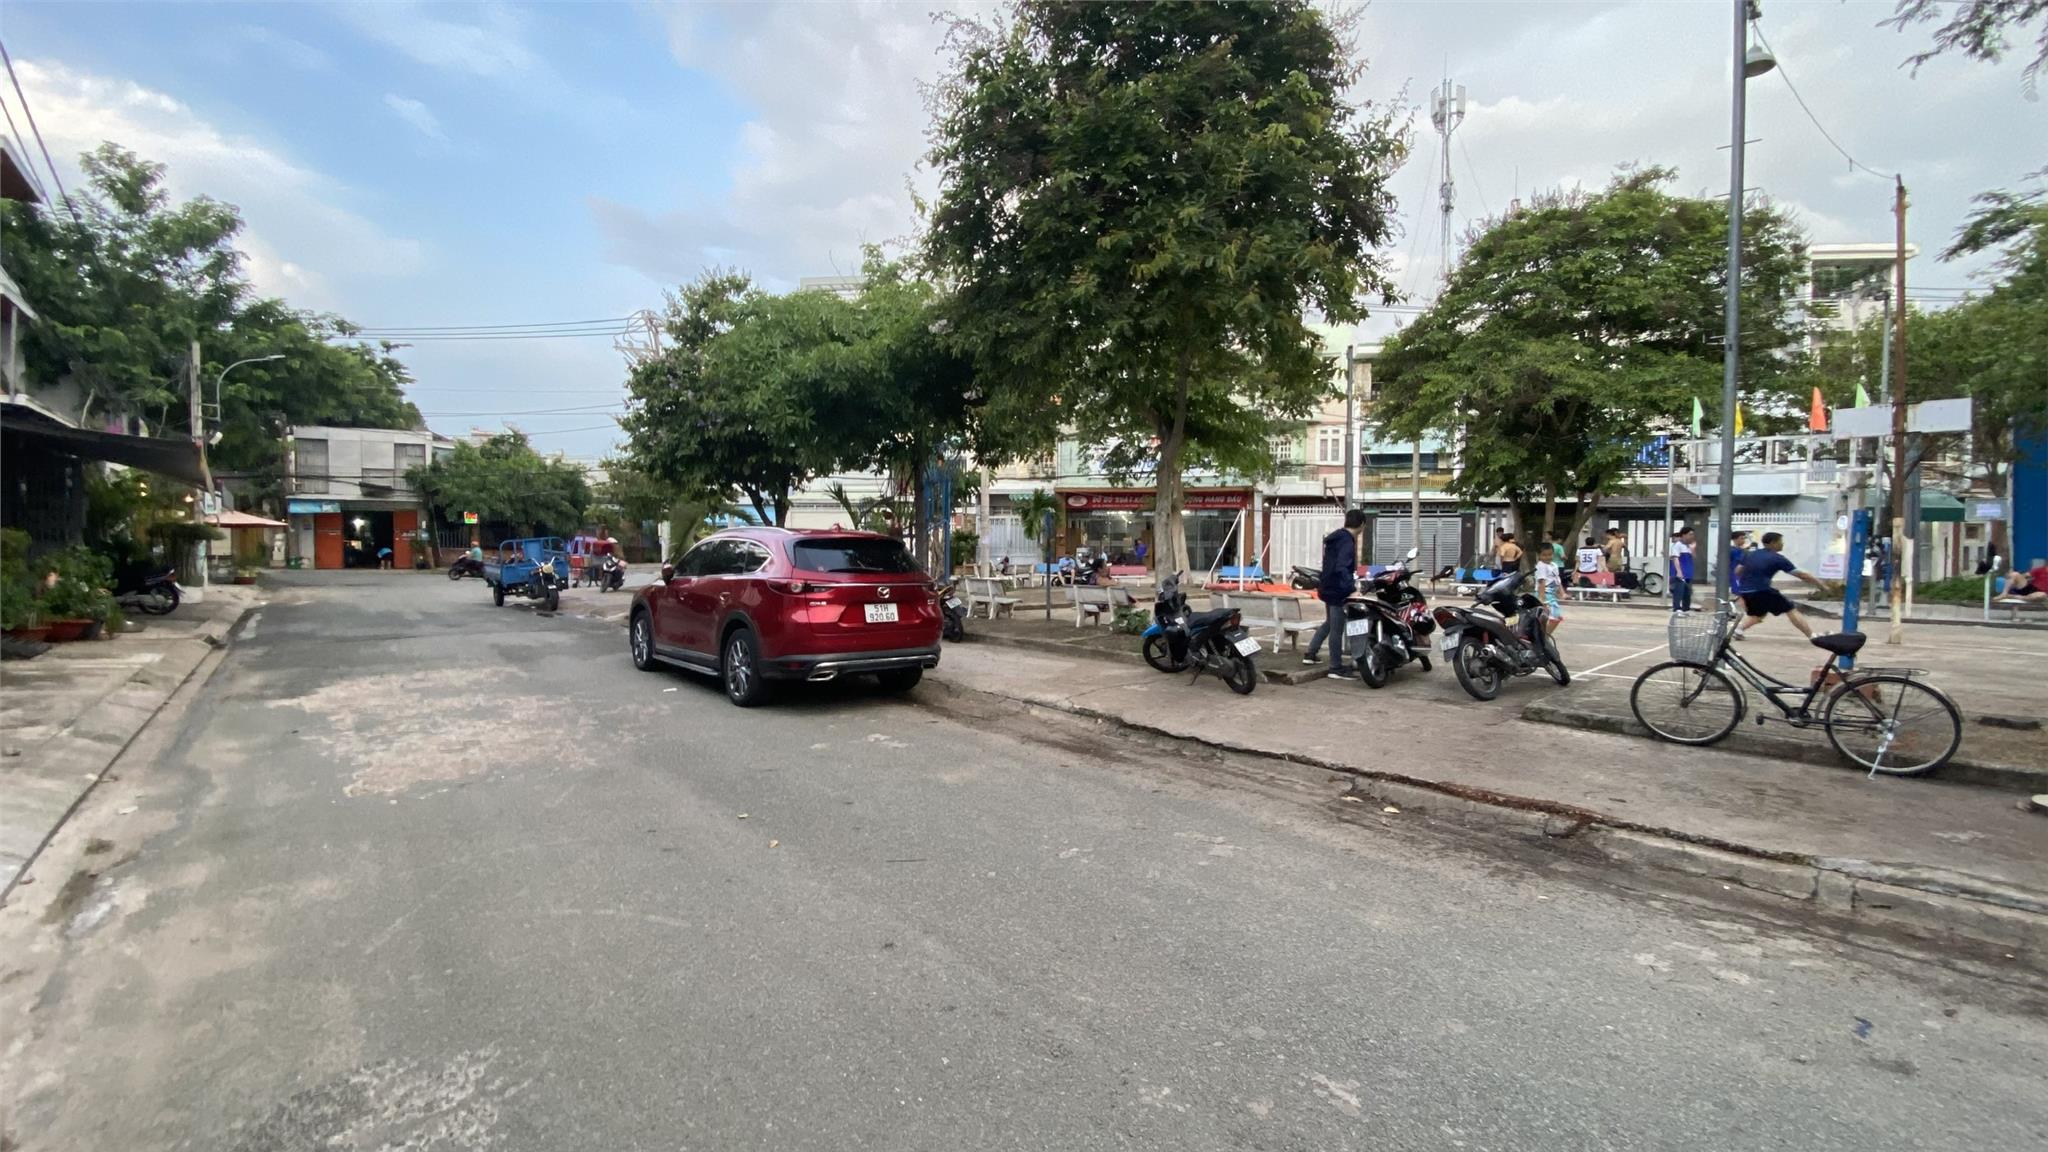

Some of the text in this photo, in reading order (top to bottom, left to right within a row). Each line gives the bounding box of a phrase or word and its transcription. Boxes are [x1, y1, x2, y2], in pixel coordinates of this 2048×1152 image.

[1582, 553, 1593, 563] 35
[874, 604, 889, 612] 51H
[869, 612, 895, 621] 920.60
